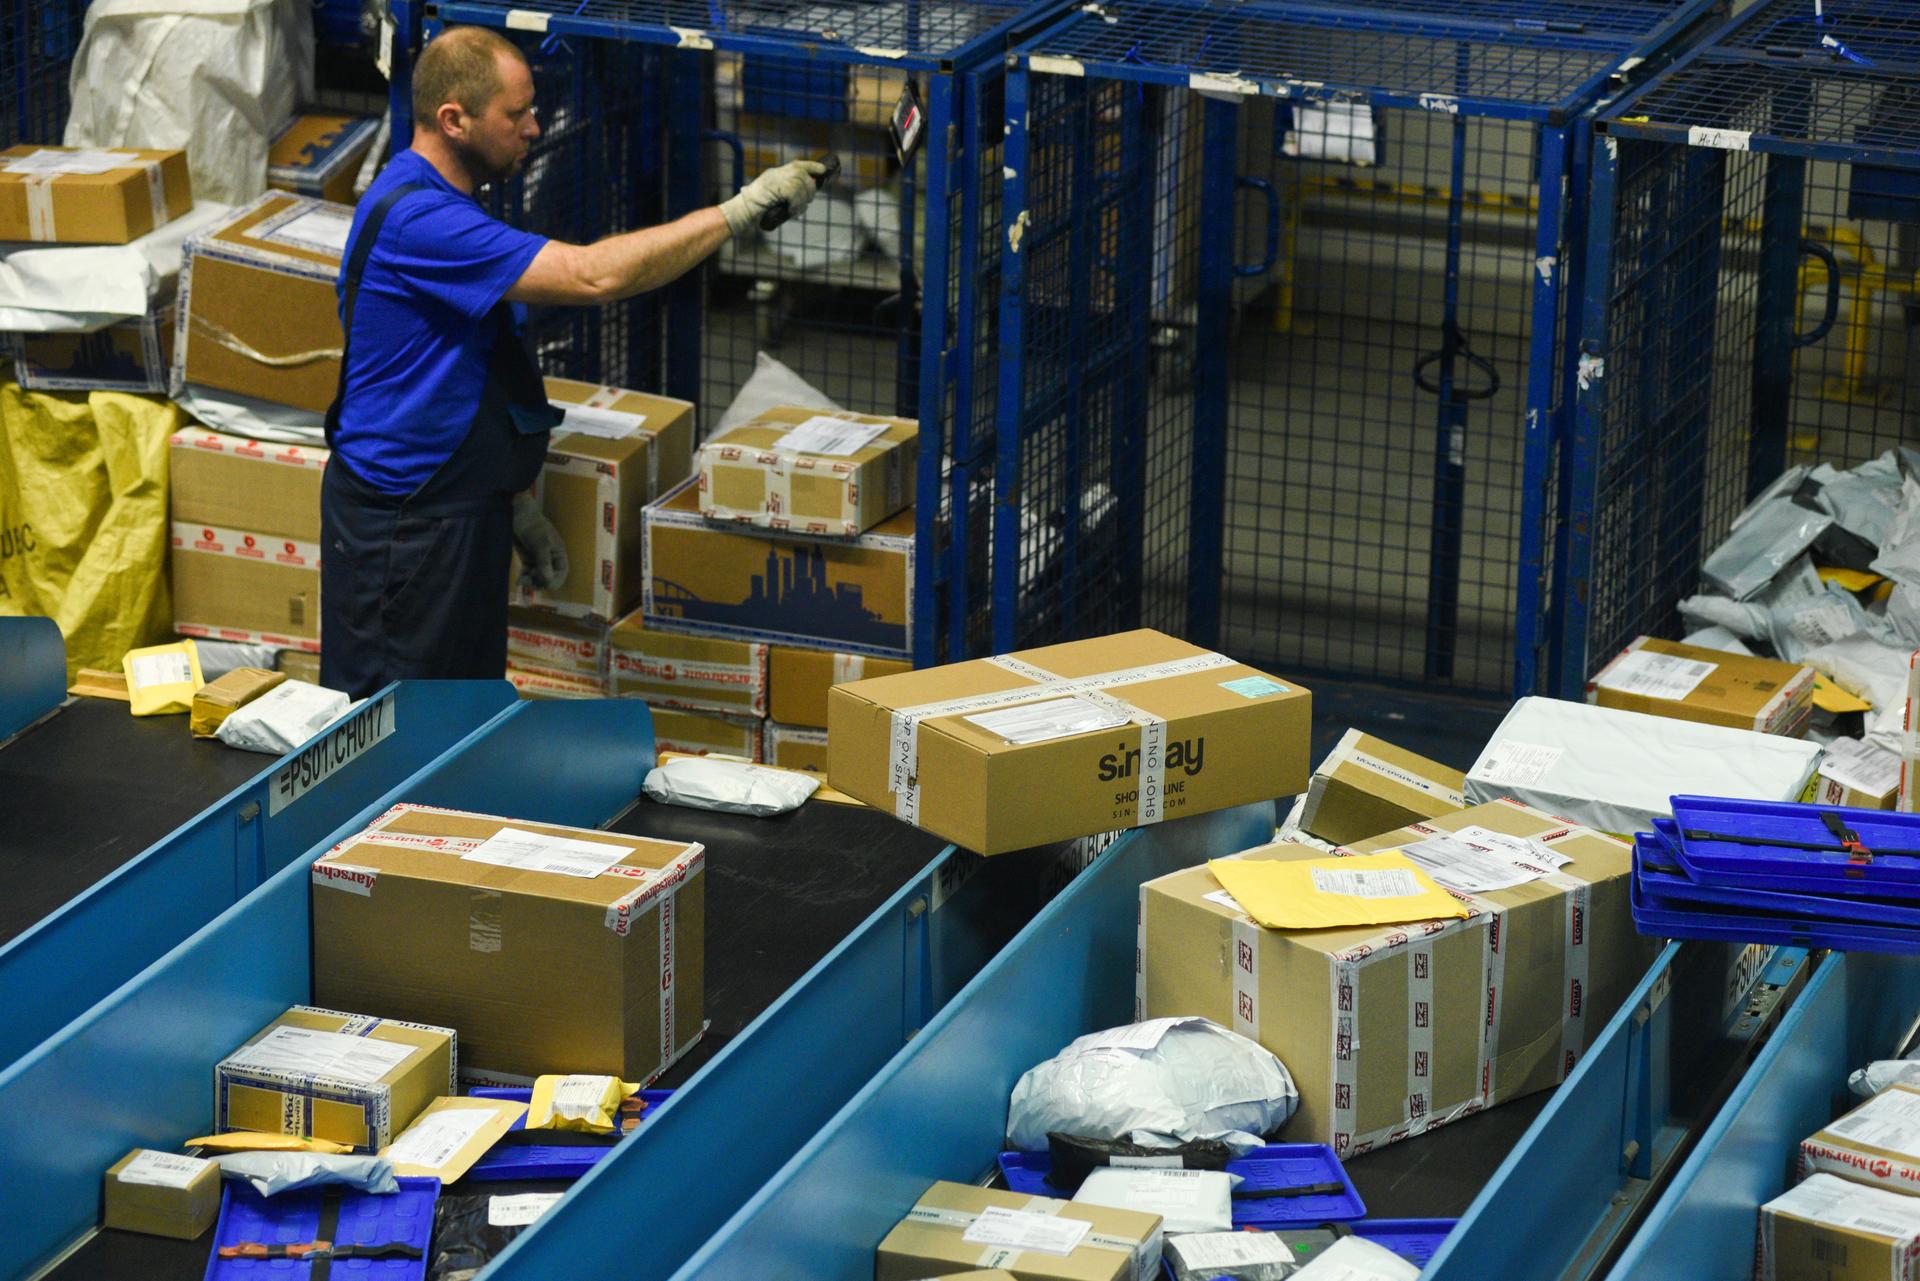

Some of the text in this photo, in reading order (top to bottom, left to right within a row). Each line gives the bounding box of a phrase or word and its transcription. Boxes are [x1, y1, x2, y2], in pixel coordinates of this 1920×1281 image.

[281, 699, 384, 797] =PS01.CH017
[1098, 737, 1205, 782] sinay
[1145, 775, 1157, 818] SHOP
[1575, 906, 1583, 945] LEOMAX
[1242, 943, 1252, 972] 24
[1415, 954, 1424, 978] 24
[1242, 993, 1252, 1022] 24
[1343, 986, 1352, 1011] 24
[1573, 978, 1582, 1018] LEOMAX
[1416, 1003, 1424, 1026] 24
[1415, 1052, 1423, 1076] 24
[1340, 1085, 1350, 1109] 24
